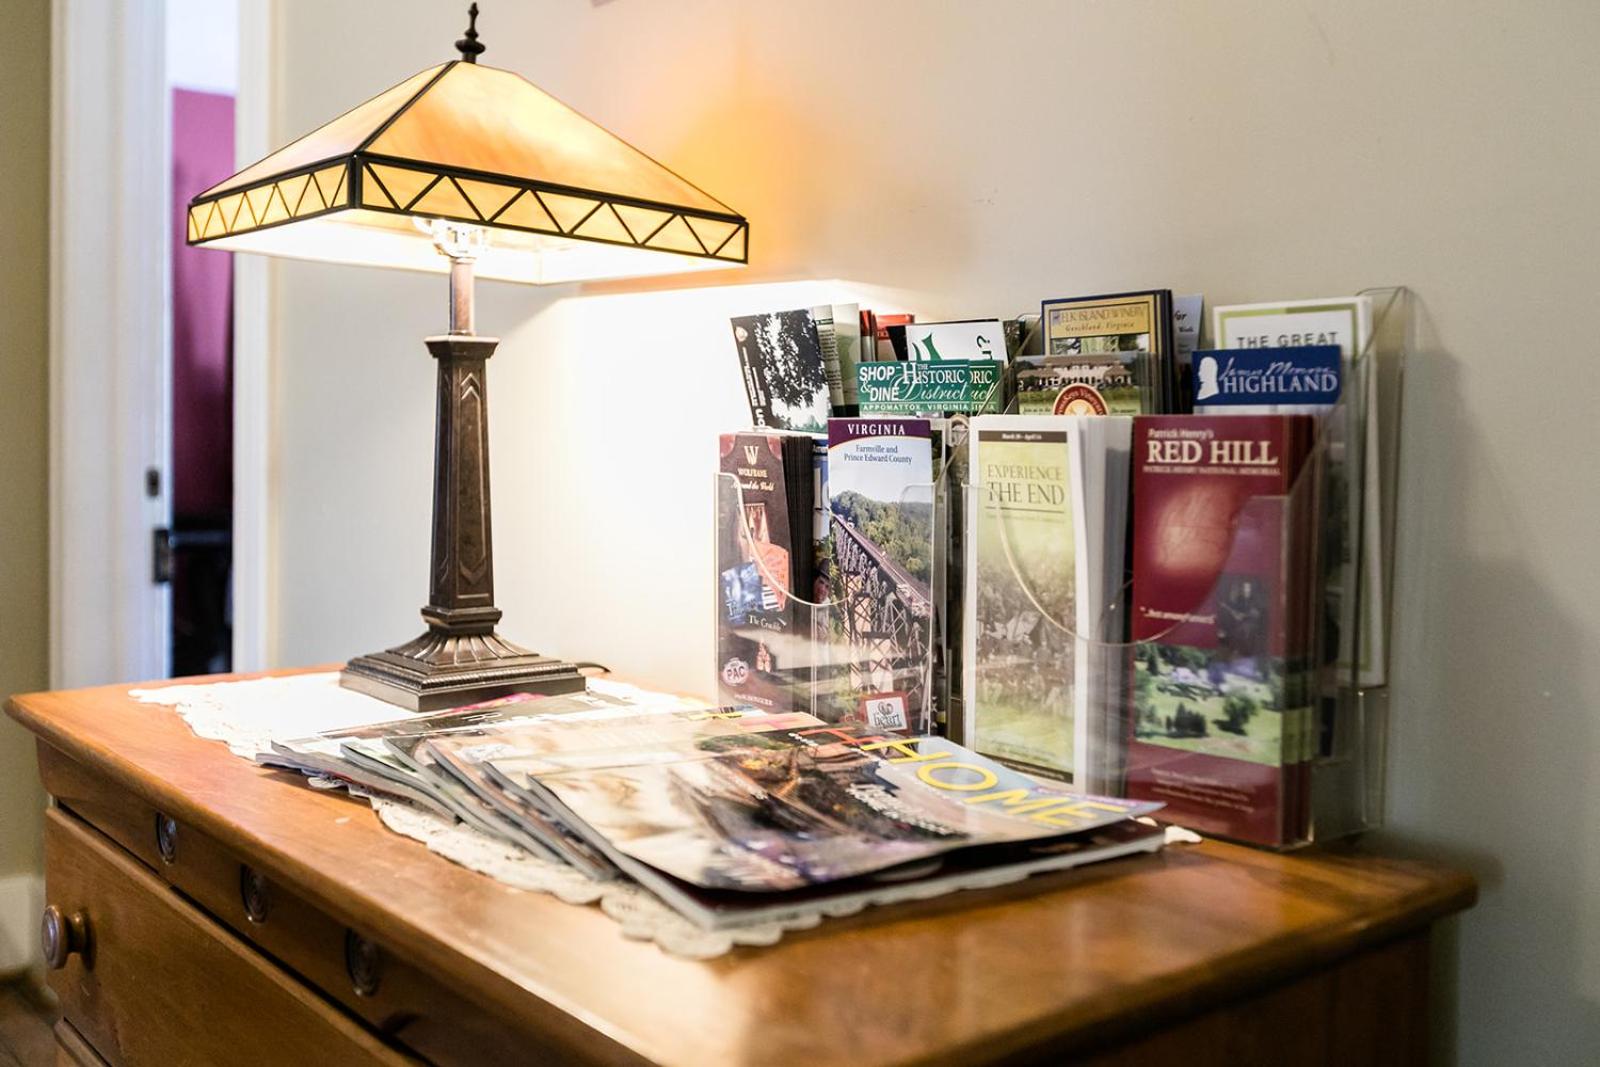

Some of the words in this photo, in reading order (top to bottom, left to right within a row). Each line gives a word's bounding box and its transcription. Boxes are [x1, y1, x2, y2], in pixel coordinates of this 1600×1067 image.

[1237, 336, 1269, 349] THE
[1277, 332, 1338, 347] GREAT
[859, 366, 895, 381] SHOP
[900, 362, 965, 384] HISTORIC
[860, 380, 873, 393] &
[889, 375, 969, 401] District
[1223, 373, 1338, 394] HIGHLAND
[869, 387, 900, 401] DINE
[864, 403, 924, 412] APPOMATTOX,
[927, 403, 967, 411] VIRGINIA
[847, 424, 905, 435] VIRGINIA
[855, 444, 885, 454] Farmville
[886, 445, 898, 454] and
[1147, 440, 1203, 464] RED
[1209, 440, 1279, 465] HILL
[844, 453, 864, 462] Prince
[864, 454, 888, 463] Edward
[889, 455, 913, 465] County
[987, 464, 1063, 480] EXPERIENCE
[986, 481, 1022, 502] THE
[1027, 483, 1065, 506] END
[726, 665, 746, 682] PAC
[860, 737, 1130, 826] HOME
